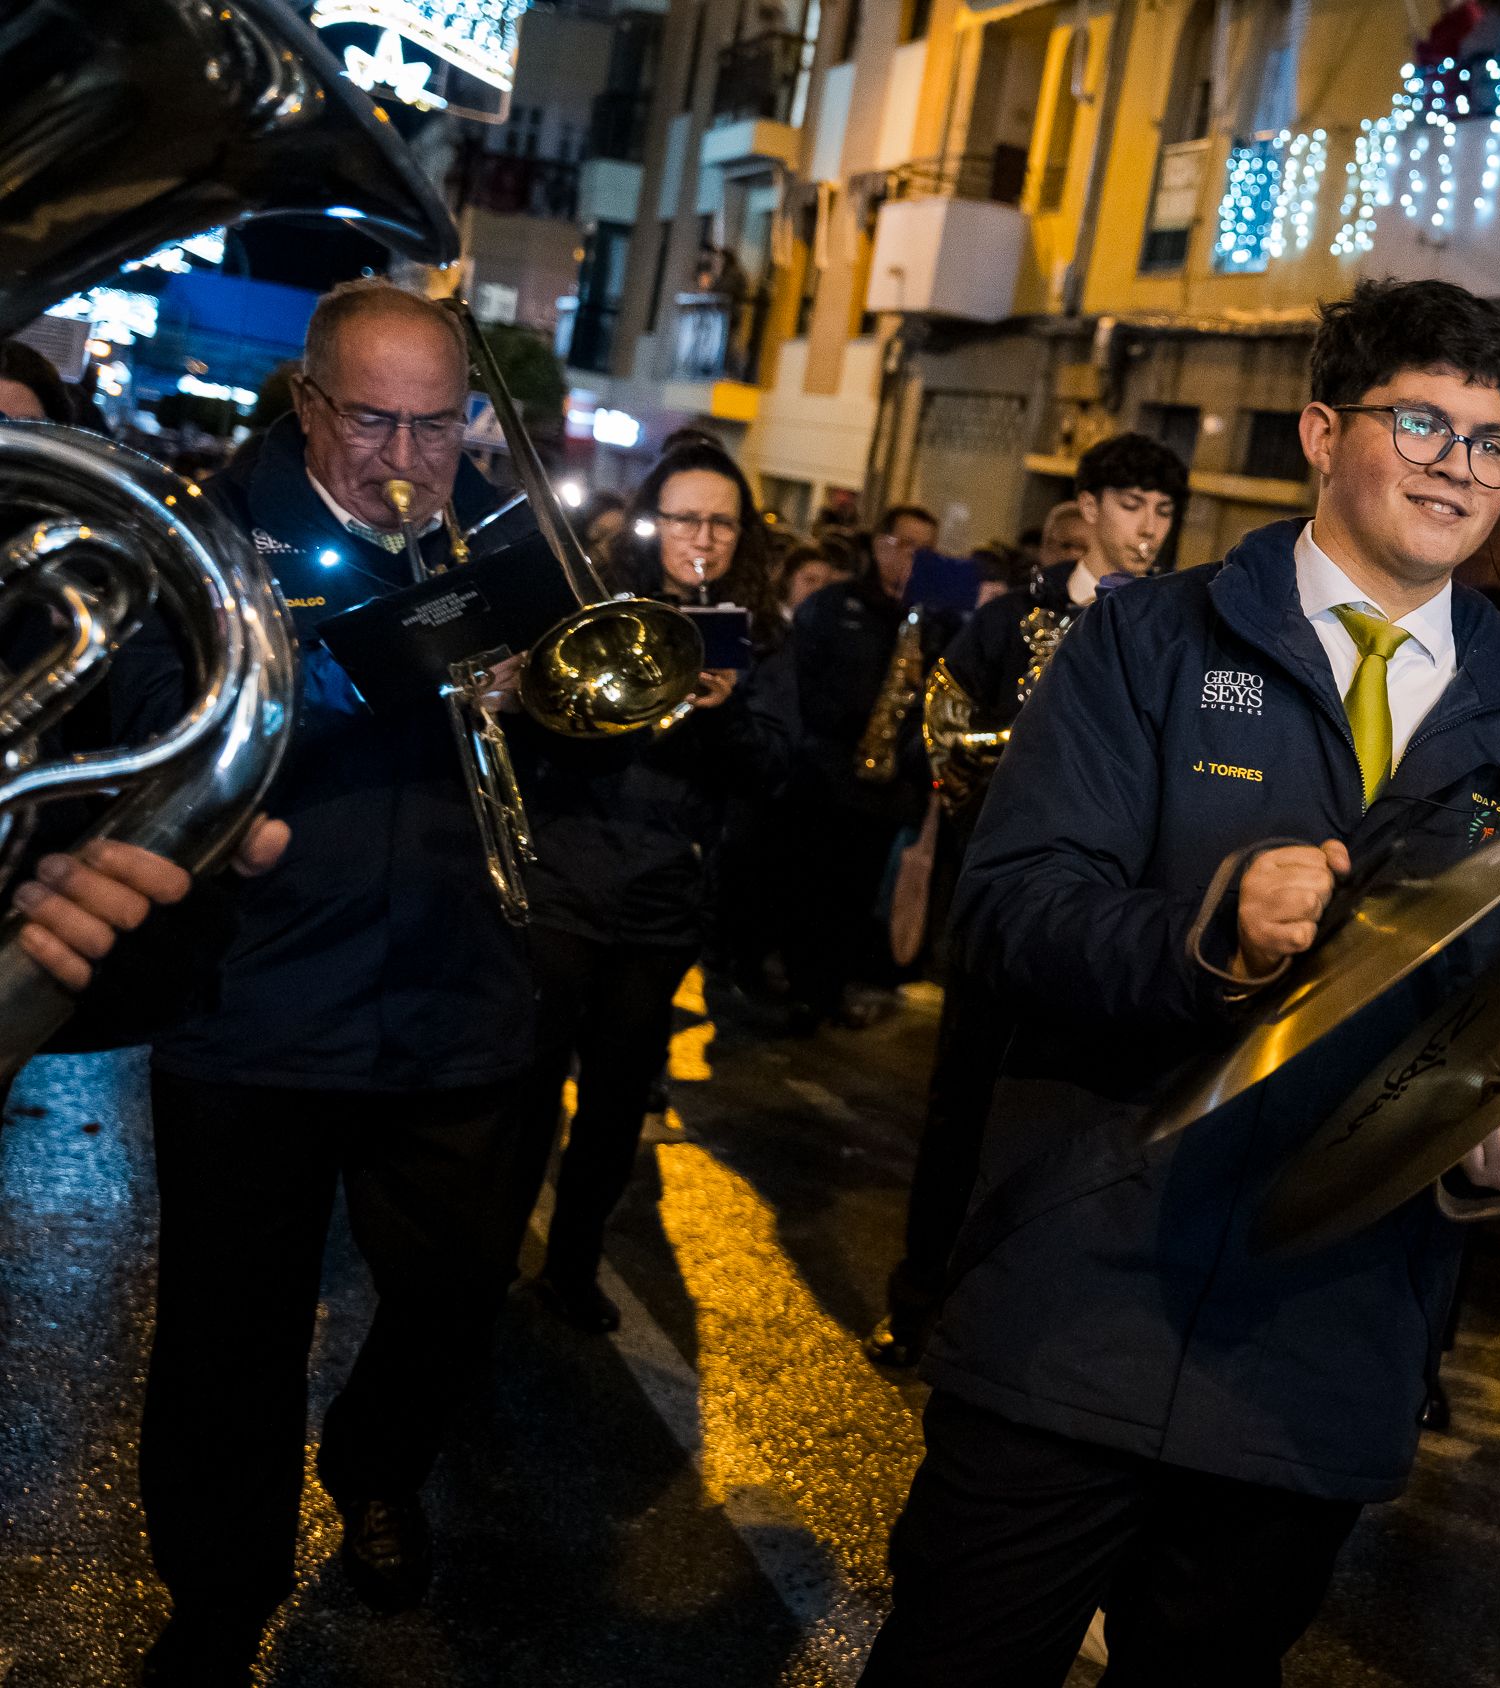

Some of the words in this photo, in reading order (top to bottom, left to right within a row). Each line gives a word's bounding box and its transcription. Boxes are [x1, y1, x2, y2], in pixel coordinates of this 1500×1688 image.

[1204, 670, 1264, 689] GRUPO
[1202, 684, 1263, 708] SEYS
[1201, 703, 1262, 716] MUEBLES
[1193, 760, 1205, 772] J.
[1208, 763, 1263, 782] TORRES
